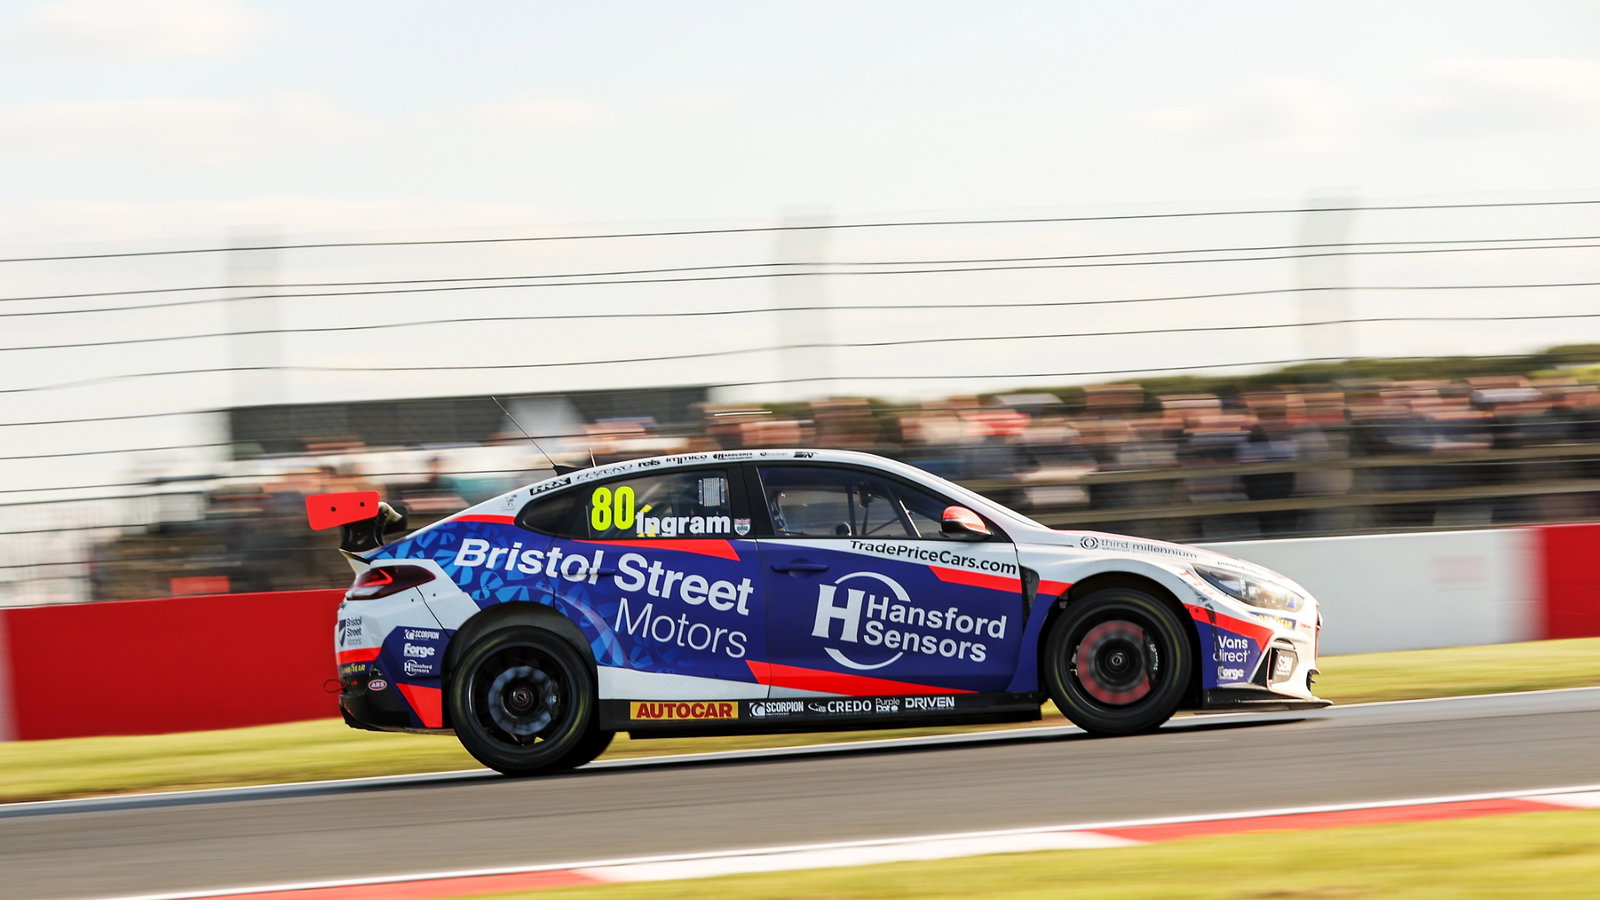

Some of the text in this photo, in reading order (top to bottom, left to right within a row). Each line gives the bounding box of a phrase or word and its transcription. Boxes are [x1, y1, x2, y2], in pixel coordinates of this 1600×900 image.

[591, 485, 635, 531] 80
[636, 511, 731, 537] Ingram
[850, 540, 1017, 575] TradePriceCars.com
[1101, 538, 1198, 559] third millennium
[453, 538, 754, 616] Bristol Street
[866, 594, 1007, 640] Hansford
[614, 598, 748, 659] Motors
[404, 643, 436, 658] Forge
[863, 620, 987, 663] Sensors
[1218, 636, 1248, 649] Vans
[635, 702, 733, 719] AUTOCAR
[766, 701, 804, 713] SCORPION
[827, 700, 872, 713] CREDO
[875, 697, 900, 707] Purple
[905, 696, 955, 710] DRIVEN
